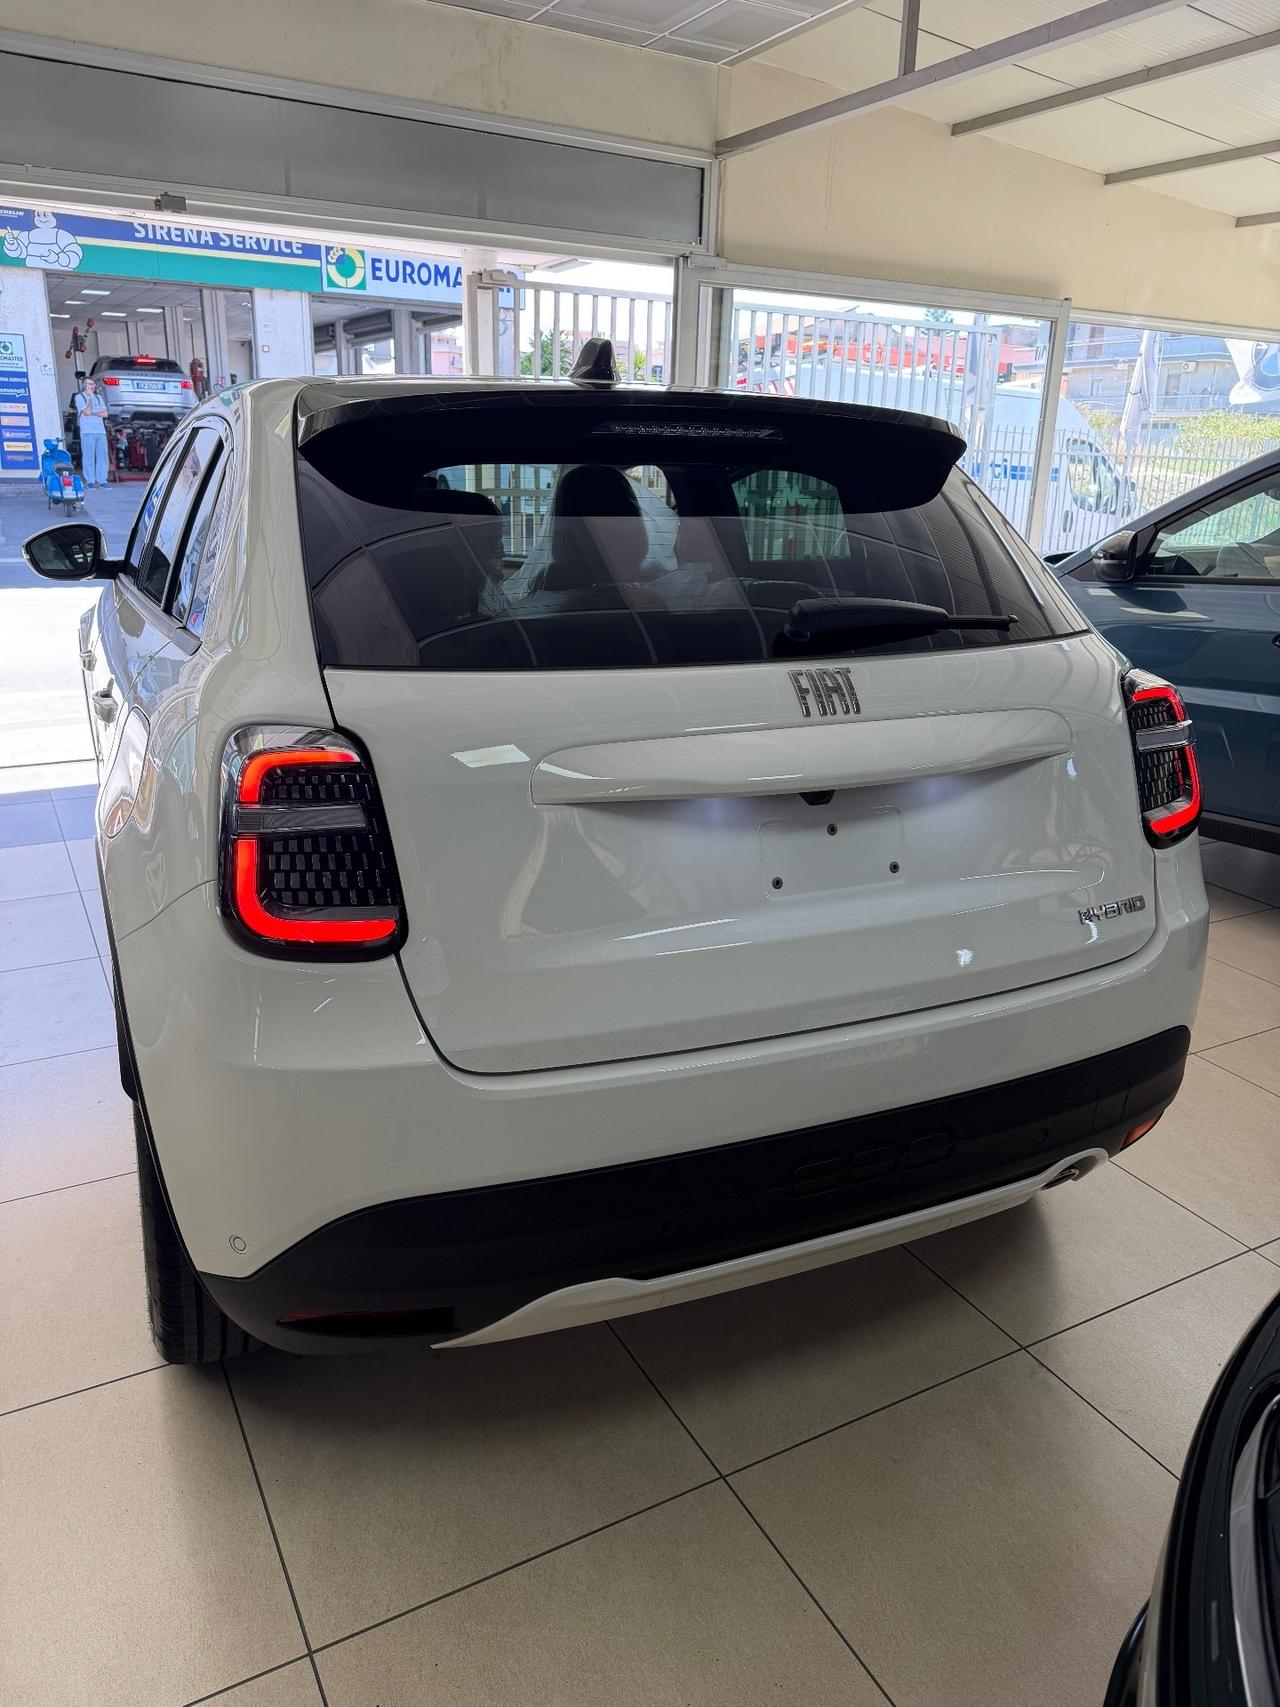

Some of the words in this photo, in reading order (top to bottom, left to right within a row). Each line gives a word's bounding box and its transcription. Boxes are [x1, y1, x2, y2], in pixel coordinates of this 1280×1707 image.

[134, 223, 213, 246] SIRENA
[219, 233, 302, 255] SERVICE
[787, 667, 861, 718] FIAT
[1078, 895, 1146, 925] HYBRID
